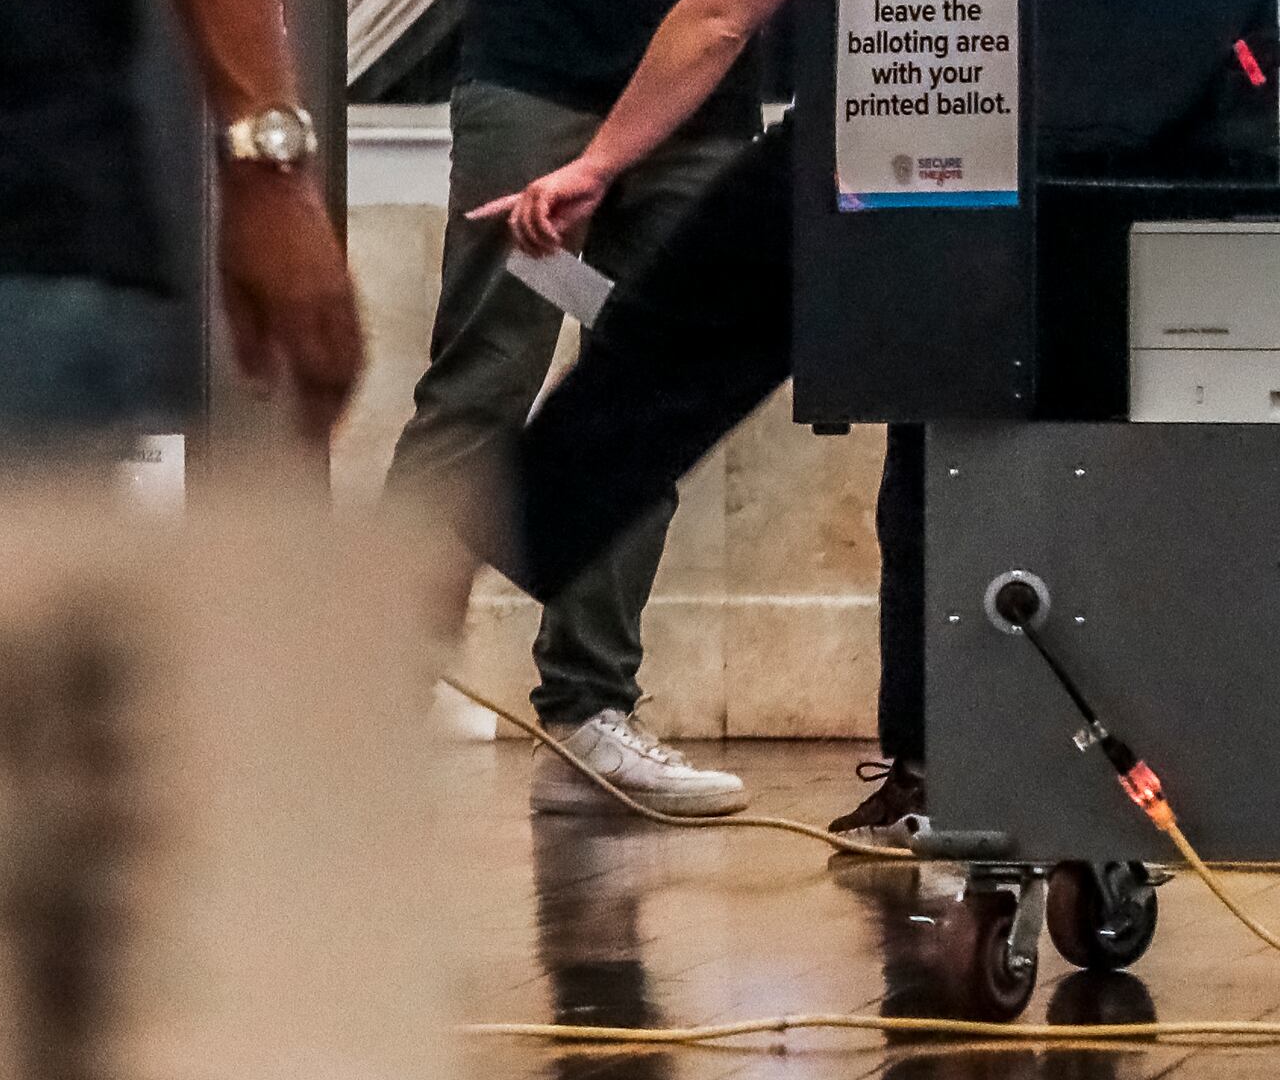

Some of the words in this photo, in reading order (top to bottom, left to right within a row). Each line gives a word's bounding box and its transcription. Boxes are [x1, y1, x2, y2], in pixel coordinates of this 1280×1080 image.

[874, 0, 936, 22] leave
[942, 0, 982, 21] the
[848, 30, 949, 58] balloting
[956, 34, 1009, 52] area
[872, 62, 922, 84] with
[930, 65, 983, 90] your
[846, 92, 929, 121] printed
[937, 92, 1011, 115] ballot.
[917, 158, 962, 168] SECURE
